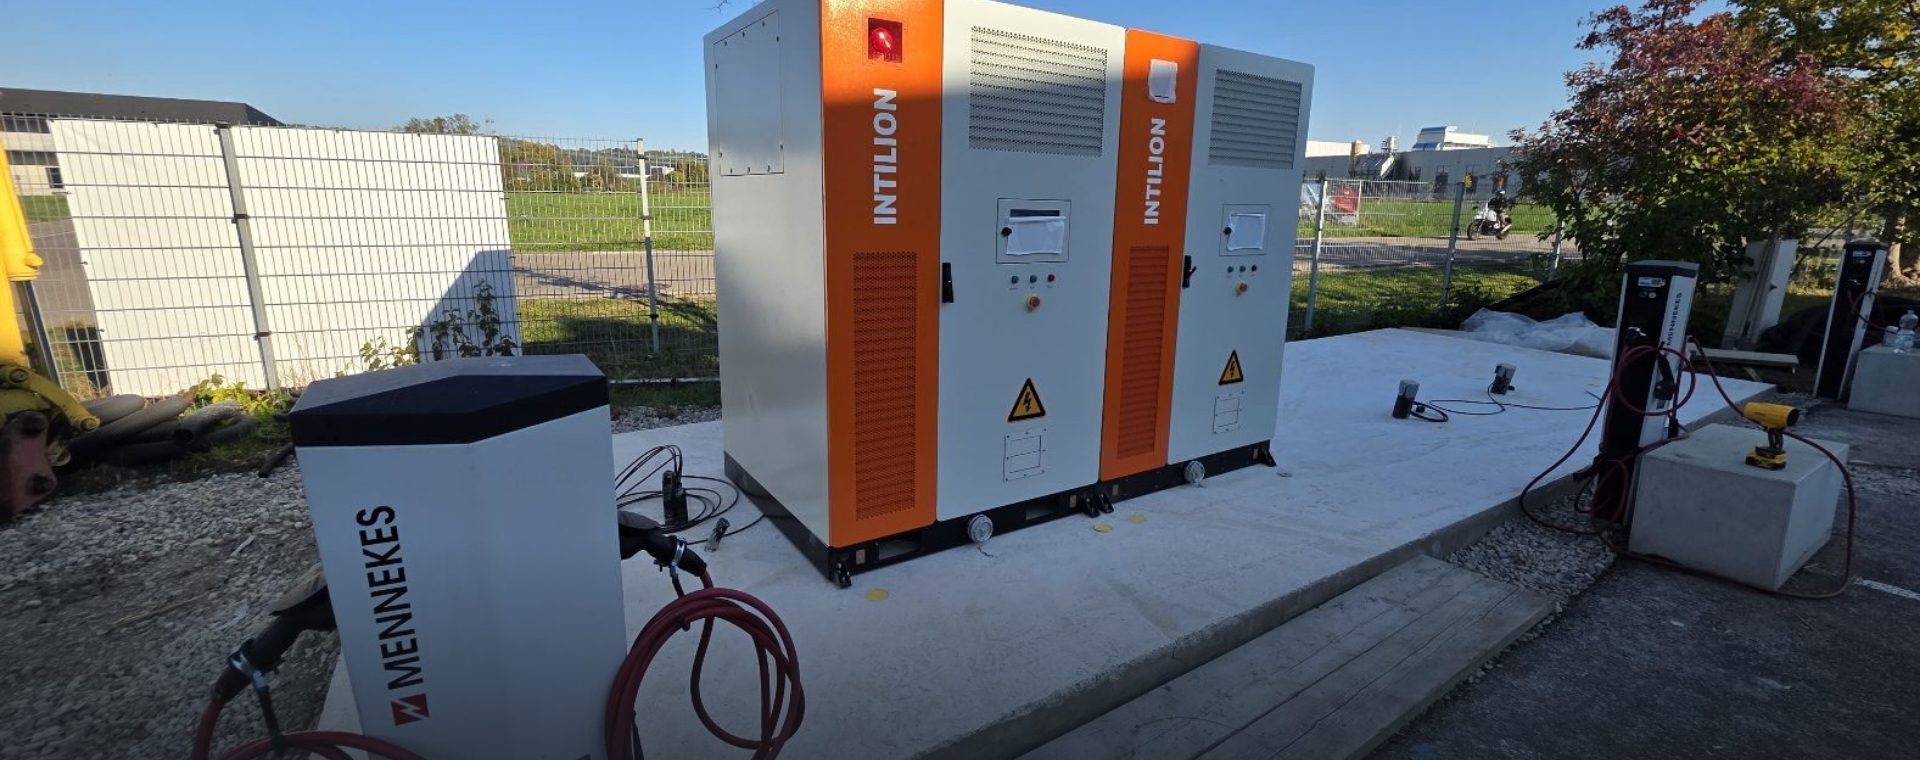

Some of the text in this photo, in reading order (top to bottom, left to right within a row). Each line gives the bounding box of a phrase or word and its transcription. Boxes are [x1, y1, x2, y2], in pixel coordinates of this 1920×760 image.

[873, 88, 897, 225] INTILION
[1144, 117, 1166, 225] INTILION
[356, 505, 424, 690] MENNEKES
